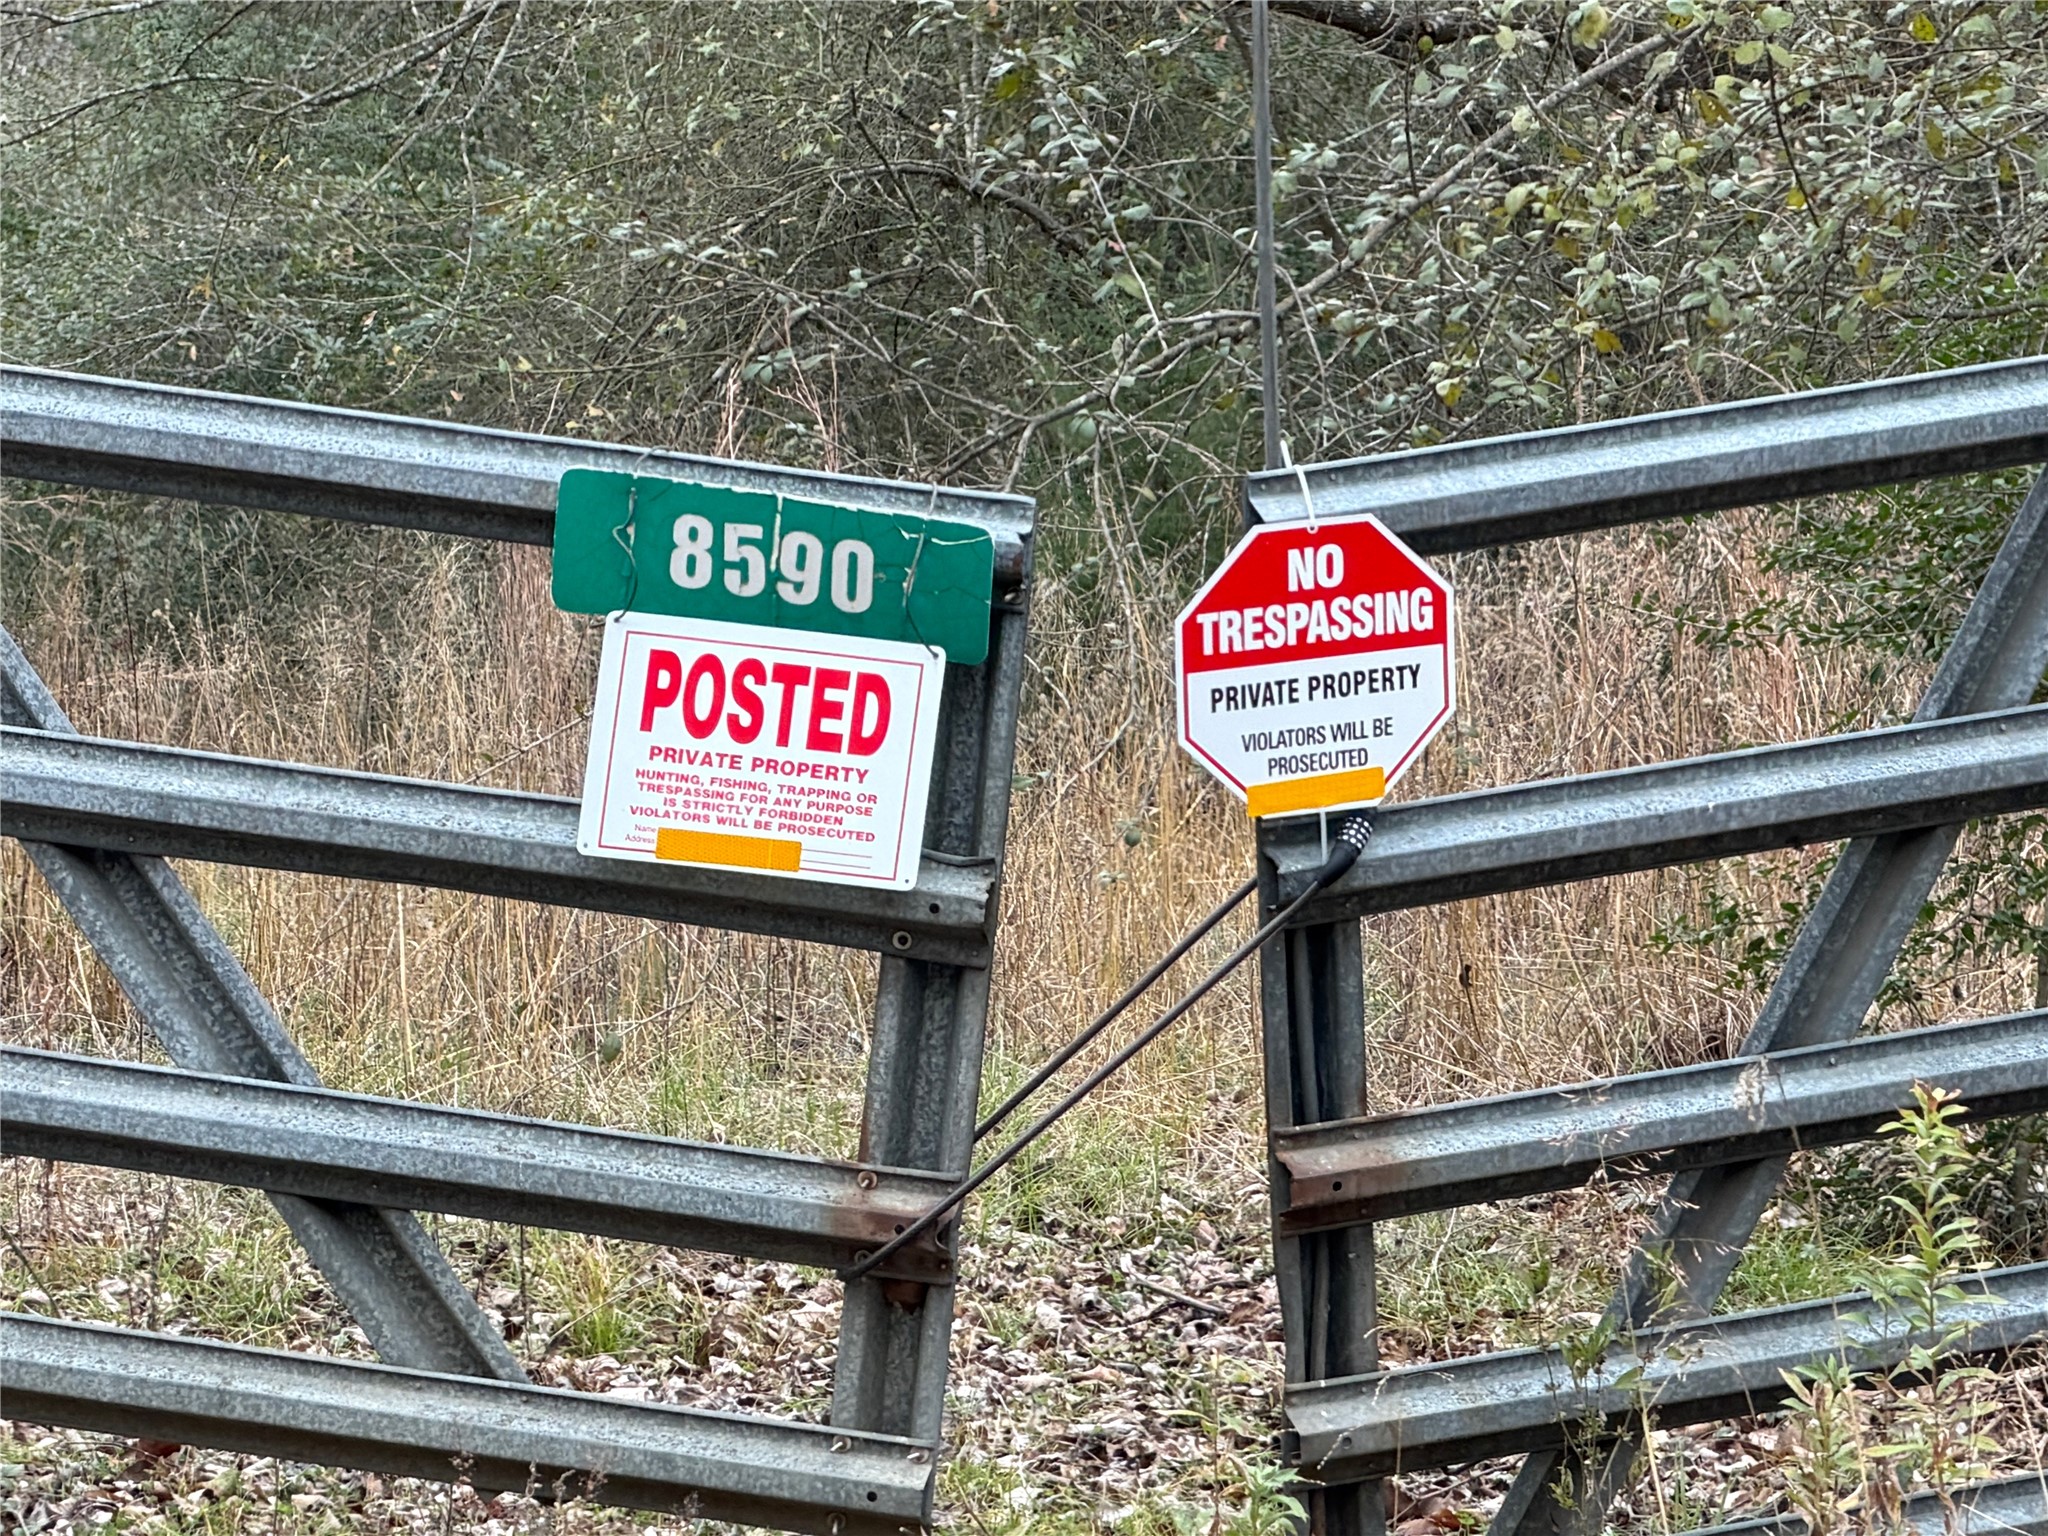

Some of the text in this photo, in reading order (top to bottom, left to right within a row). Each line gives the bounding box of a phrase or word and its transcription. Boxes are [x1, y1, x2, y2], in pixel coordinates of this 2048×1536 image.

[670, 513, 875, 614] 8590
[1287, 543, 1344, 592] NO
[1196, 586, 1434, 656] TRESPASSING
[639, 649, 892, 757] POSTED
[1210, 663, 1422, 713] PRIVATE PROPERTY
[1241, 716, 1394, 753] VIOLATORS WILL BE
[649, 745, 869, 784] PRIVATE PROPERTY
[1268, 747, 1369, 777] PROSECUTED
[635, 768, 878, 805] HUNTING, FISHING, TRAPPING OR
[638, 782, 874, 817] TRESPASSING FOR ANY PURPOSE
[630, 805, 876, 842] VIOLATORS WILL BE PROSECUTED
[663, 797, 844, 826] IS STRICTLY FORBIDDEN
